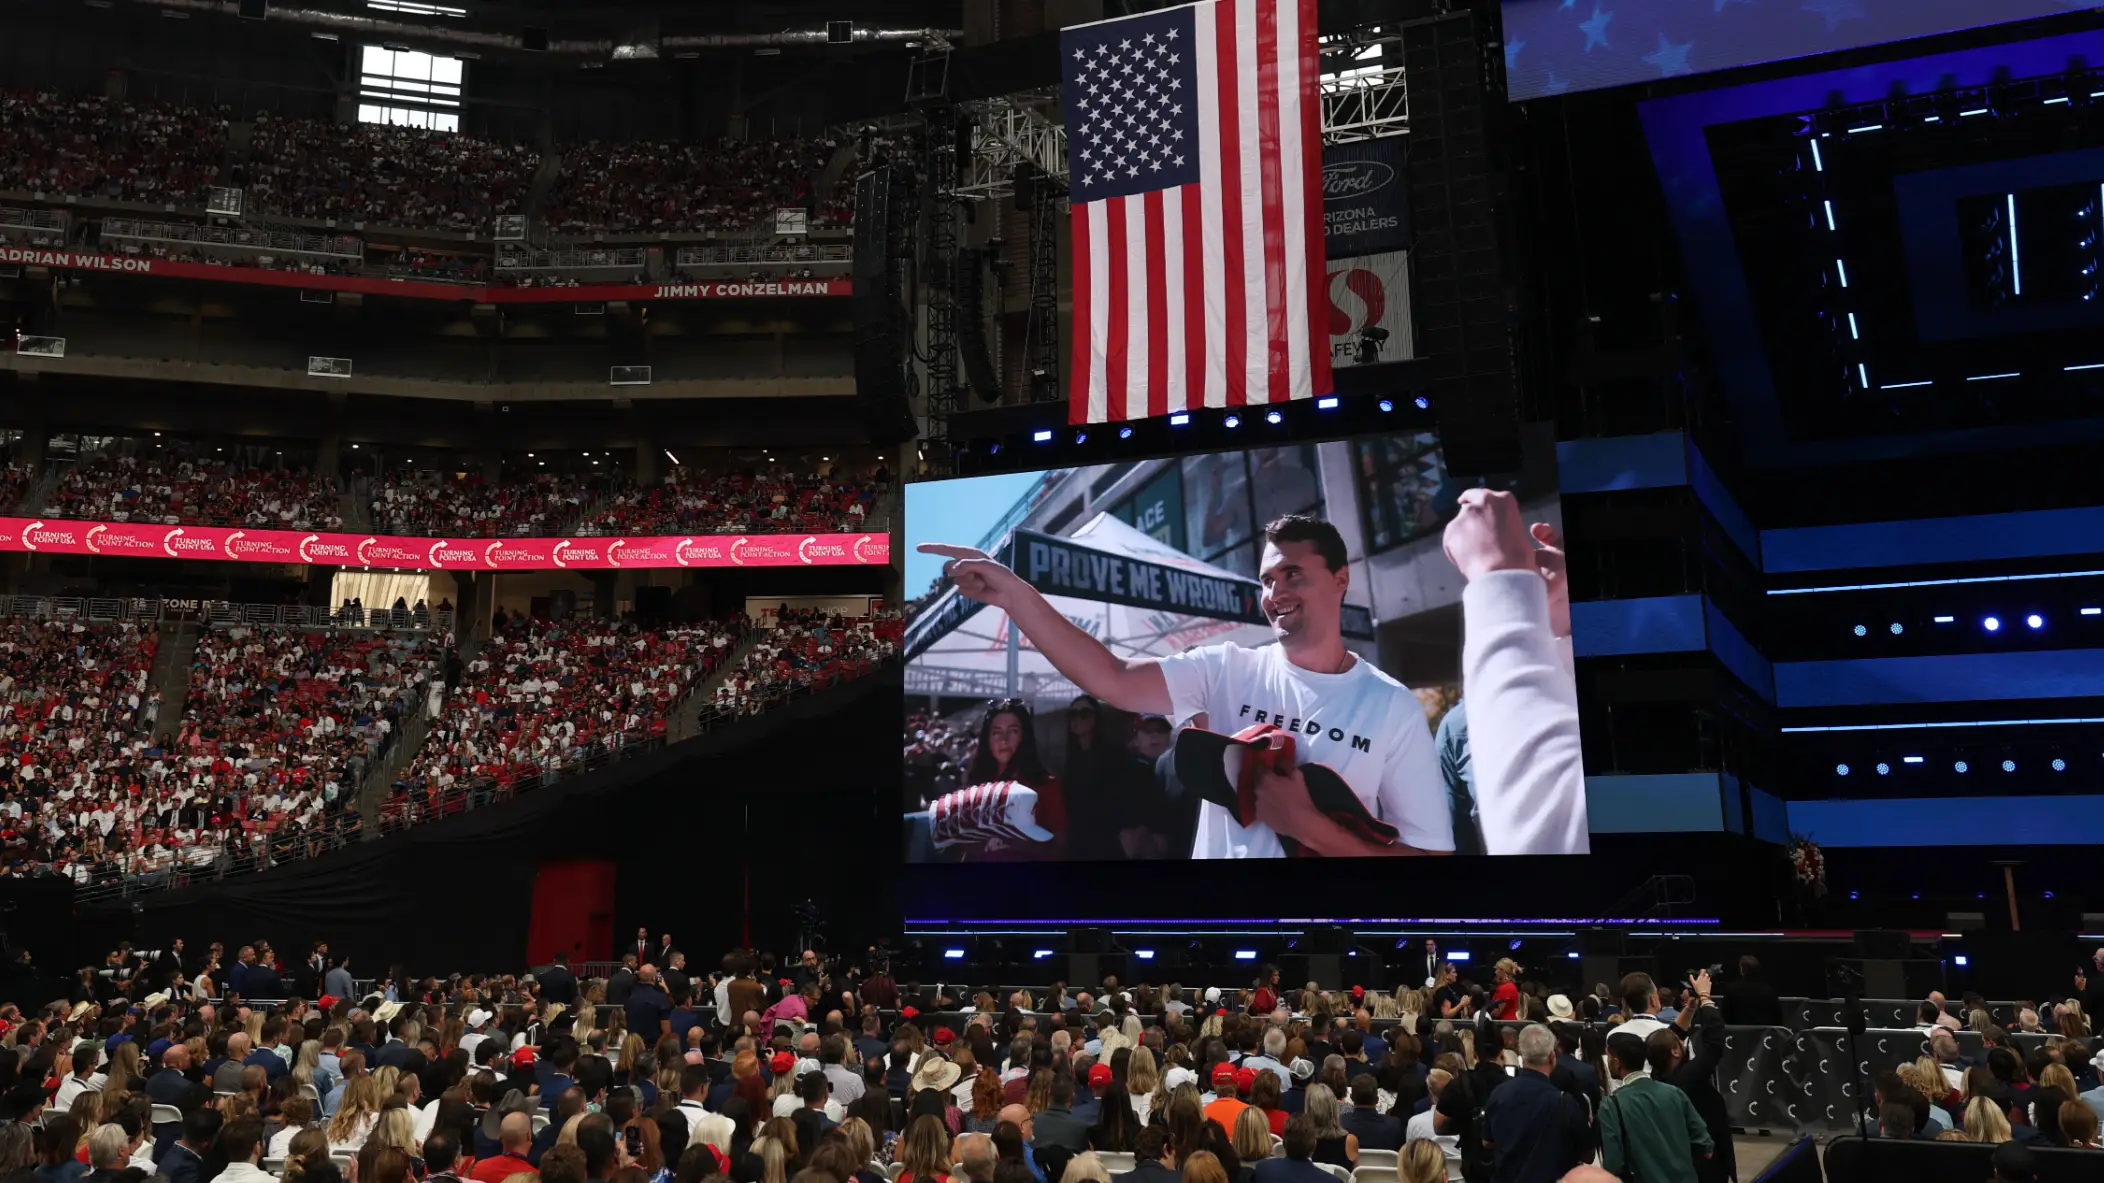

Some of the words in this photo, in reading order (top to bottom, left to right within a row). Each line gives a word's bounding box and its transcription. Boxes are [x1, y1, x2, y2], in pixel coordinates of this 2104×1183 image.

[1324, 206, 1376, 222] RIZONA
[1333, 216, 1398, 235] DEALERS
[0, 248, 69, 266] ADRIAN
[75, 255, 150, 272] WILSON
[654, 285, 711, 298] JIMMY
[716, 282, 828, 296] CONZELMAN
[33, 531, 73, 539] TURNING
[98, 534, 136, 542] TURNING
[124, 541, 154, 549] ACTION
[175, 537, 212, 546] TURNING
[236, 540, 273, 548] TURNING
[310, 544, 345, 552] TURNING
[1028, 541, 1124, 596] PROVE
[1129, 561, 1163, 602] ME
[1166, 569, 1242, 615] WRONG
[162, 599, 198, 609] ZONE
[1239, 704, 1372, 753] FREEDOM
